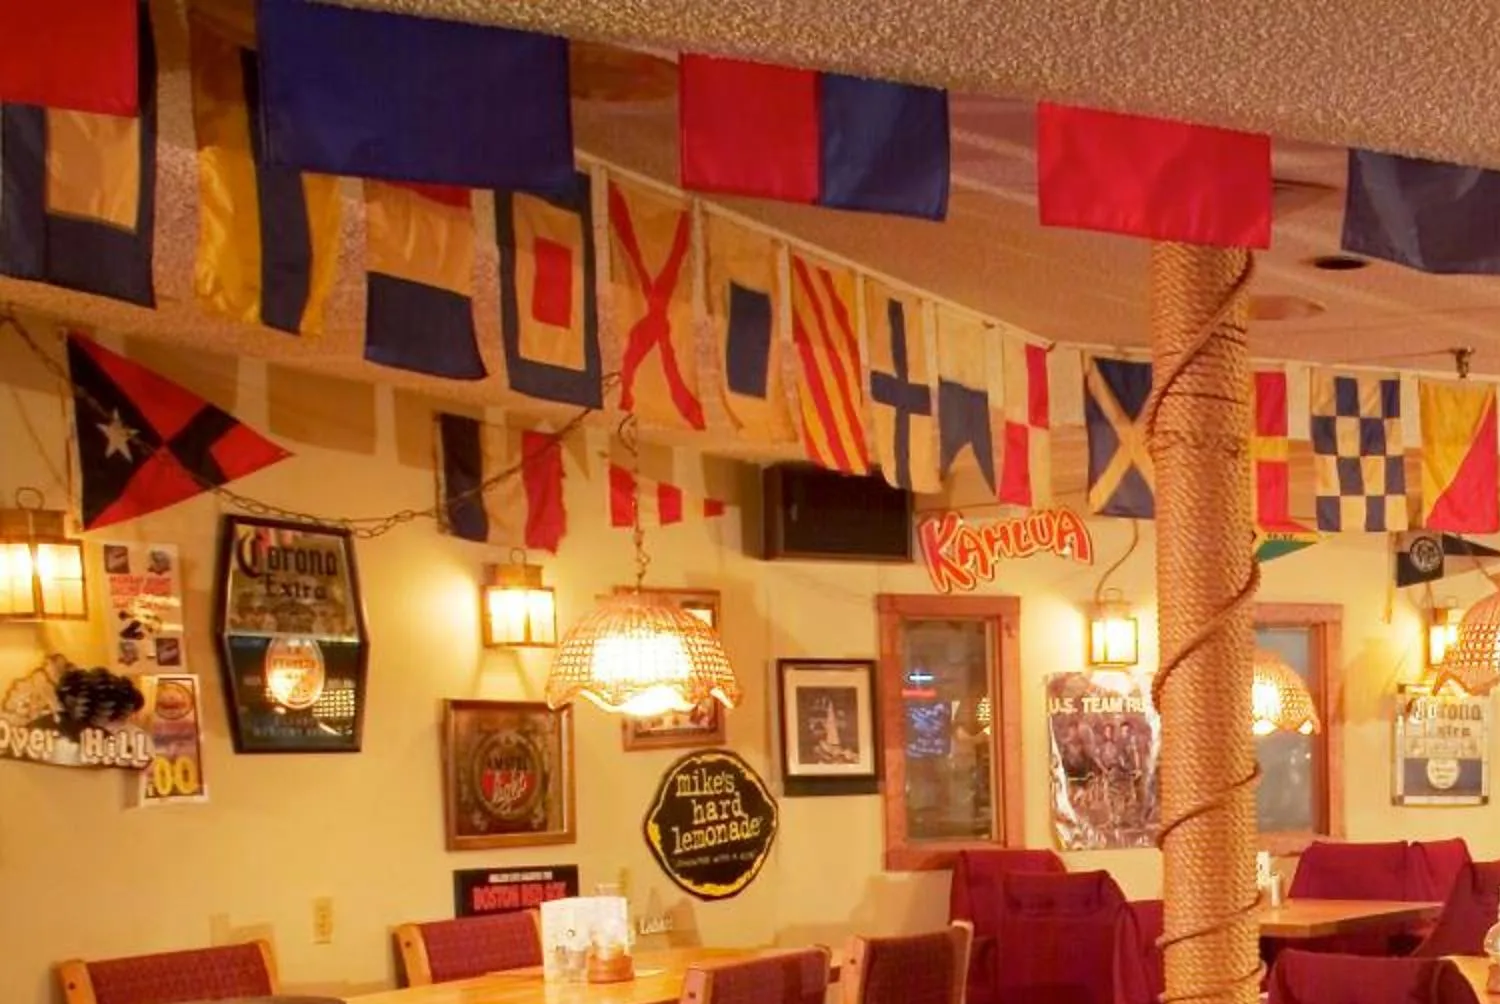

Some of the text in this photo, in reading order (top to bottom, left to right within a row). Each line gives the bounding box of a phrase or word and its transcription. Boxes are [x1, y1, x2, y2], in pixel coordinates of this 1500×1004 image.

[236, 526, 339, 579] Corona
[264, 572, 328, 601] Extra
[676, 767, 736, 797] mike's
[692, 791, 749, 825] hard
[671, 817, 761, 855] lemonade
